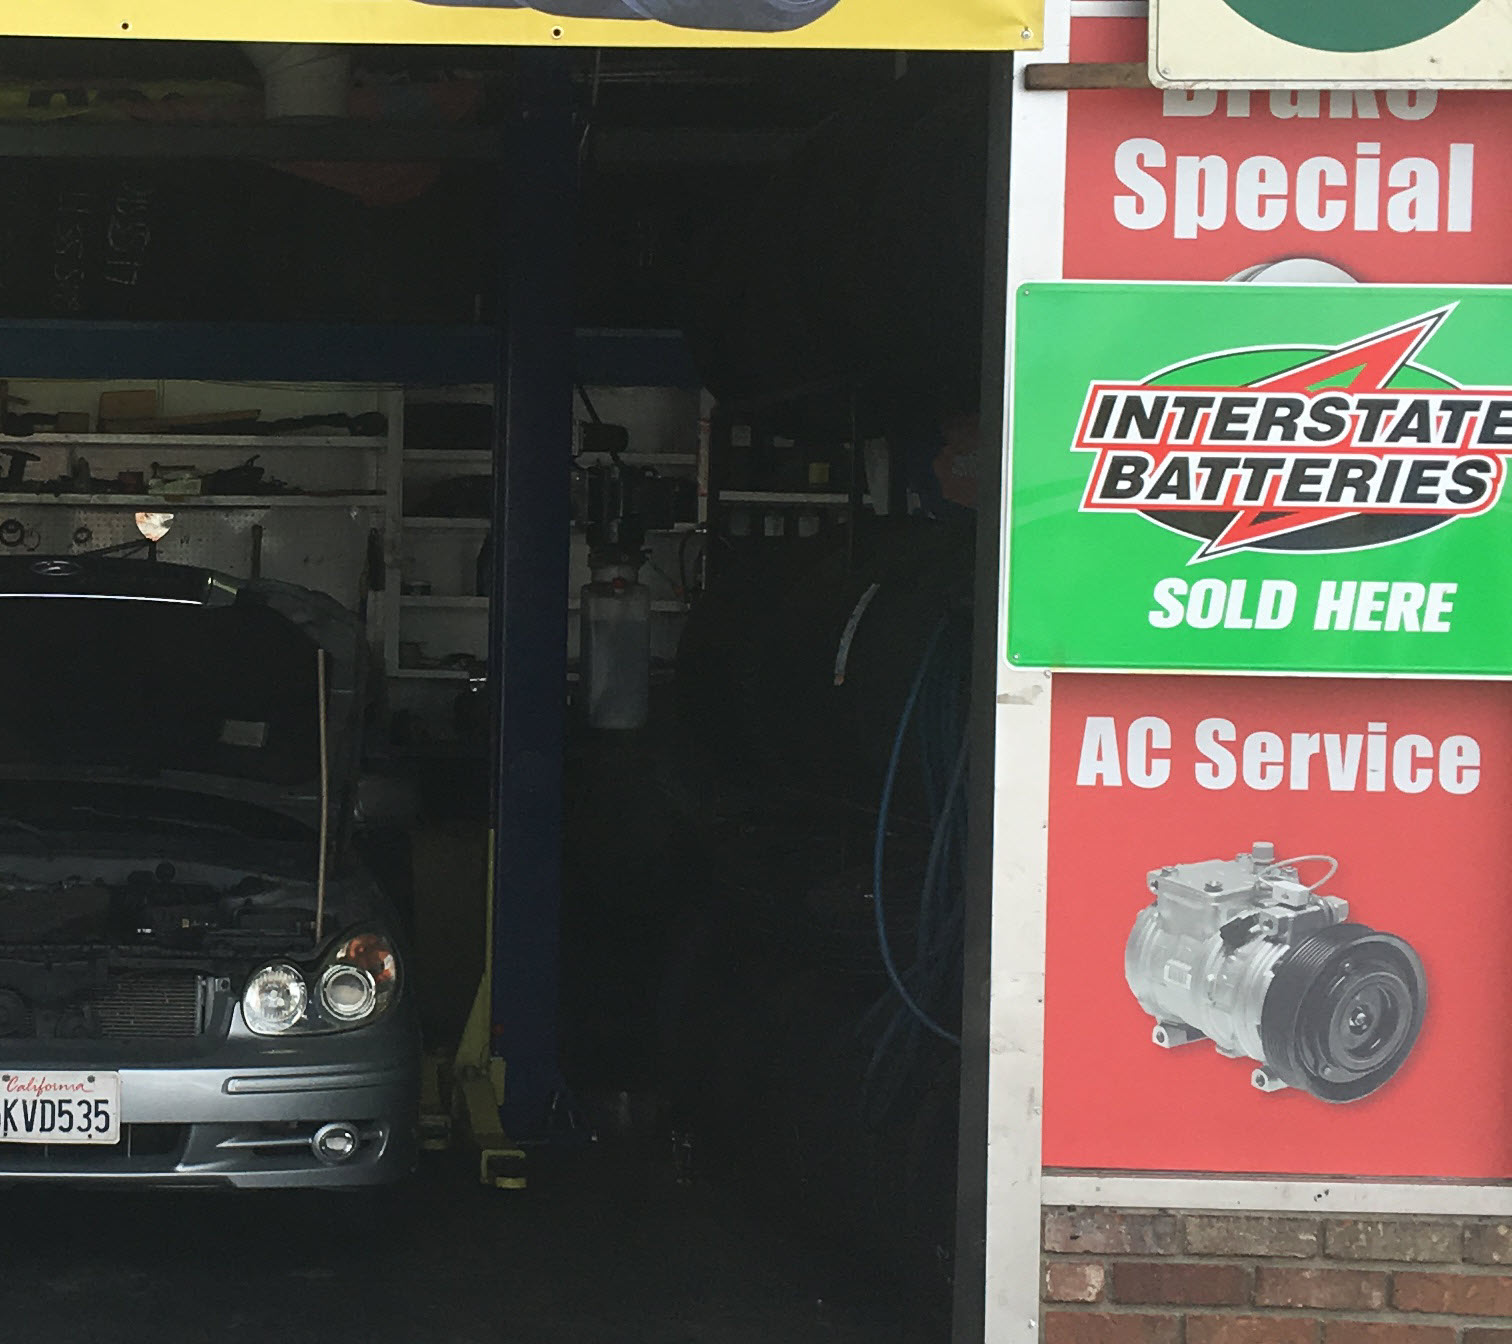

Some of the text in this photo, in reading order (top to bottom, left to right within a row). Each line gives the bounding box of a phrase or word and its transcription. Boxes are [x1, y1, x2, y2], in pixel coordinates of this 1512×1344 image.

[1113, 137, 1475, 240] Special
[1089, 394, 1512, 444] INTERSTATE
[1100, 457, 1495, 505] BATTERIES
[1148, 577, 1459, 632] SOLD HERE
[1076, 716, 1482, 795] AC Service
[7, 1075, 94, 1097] California
